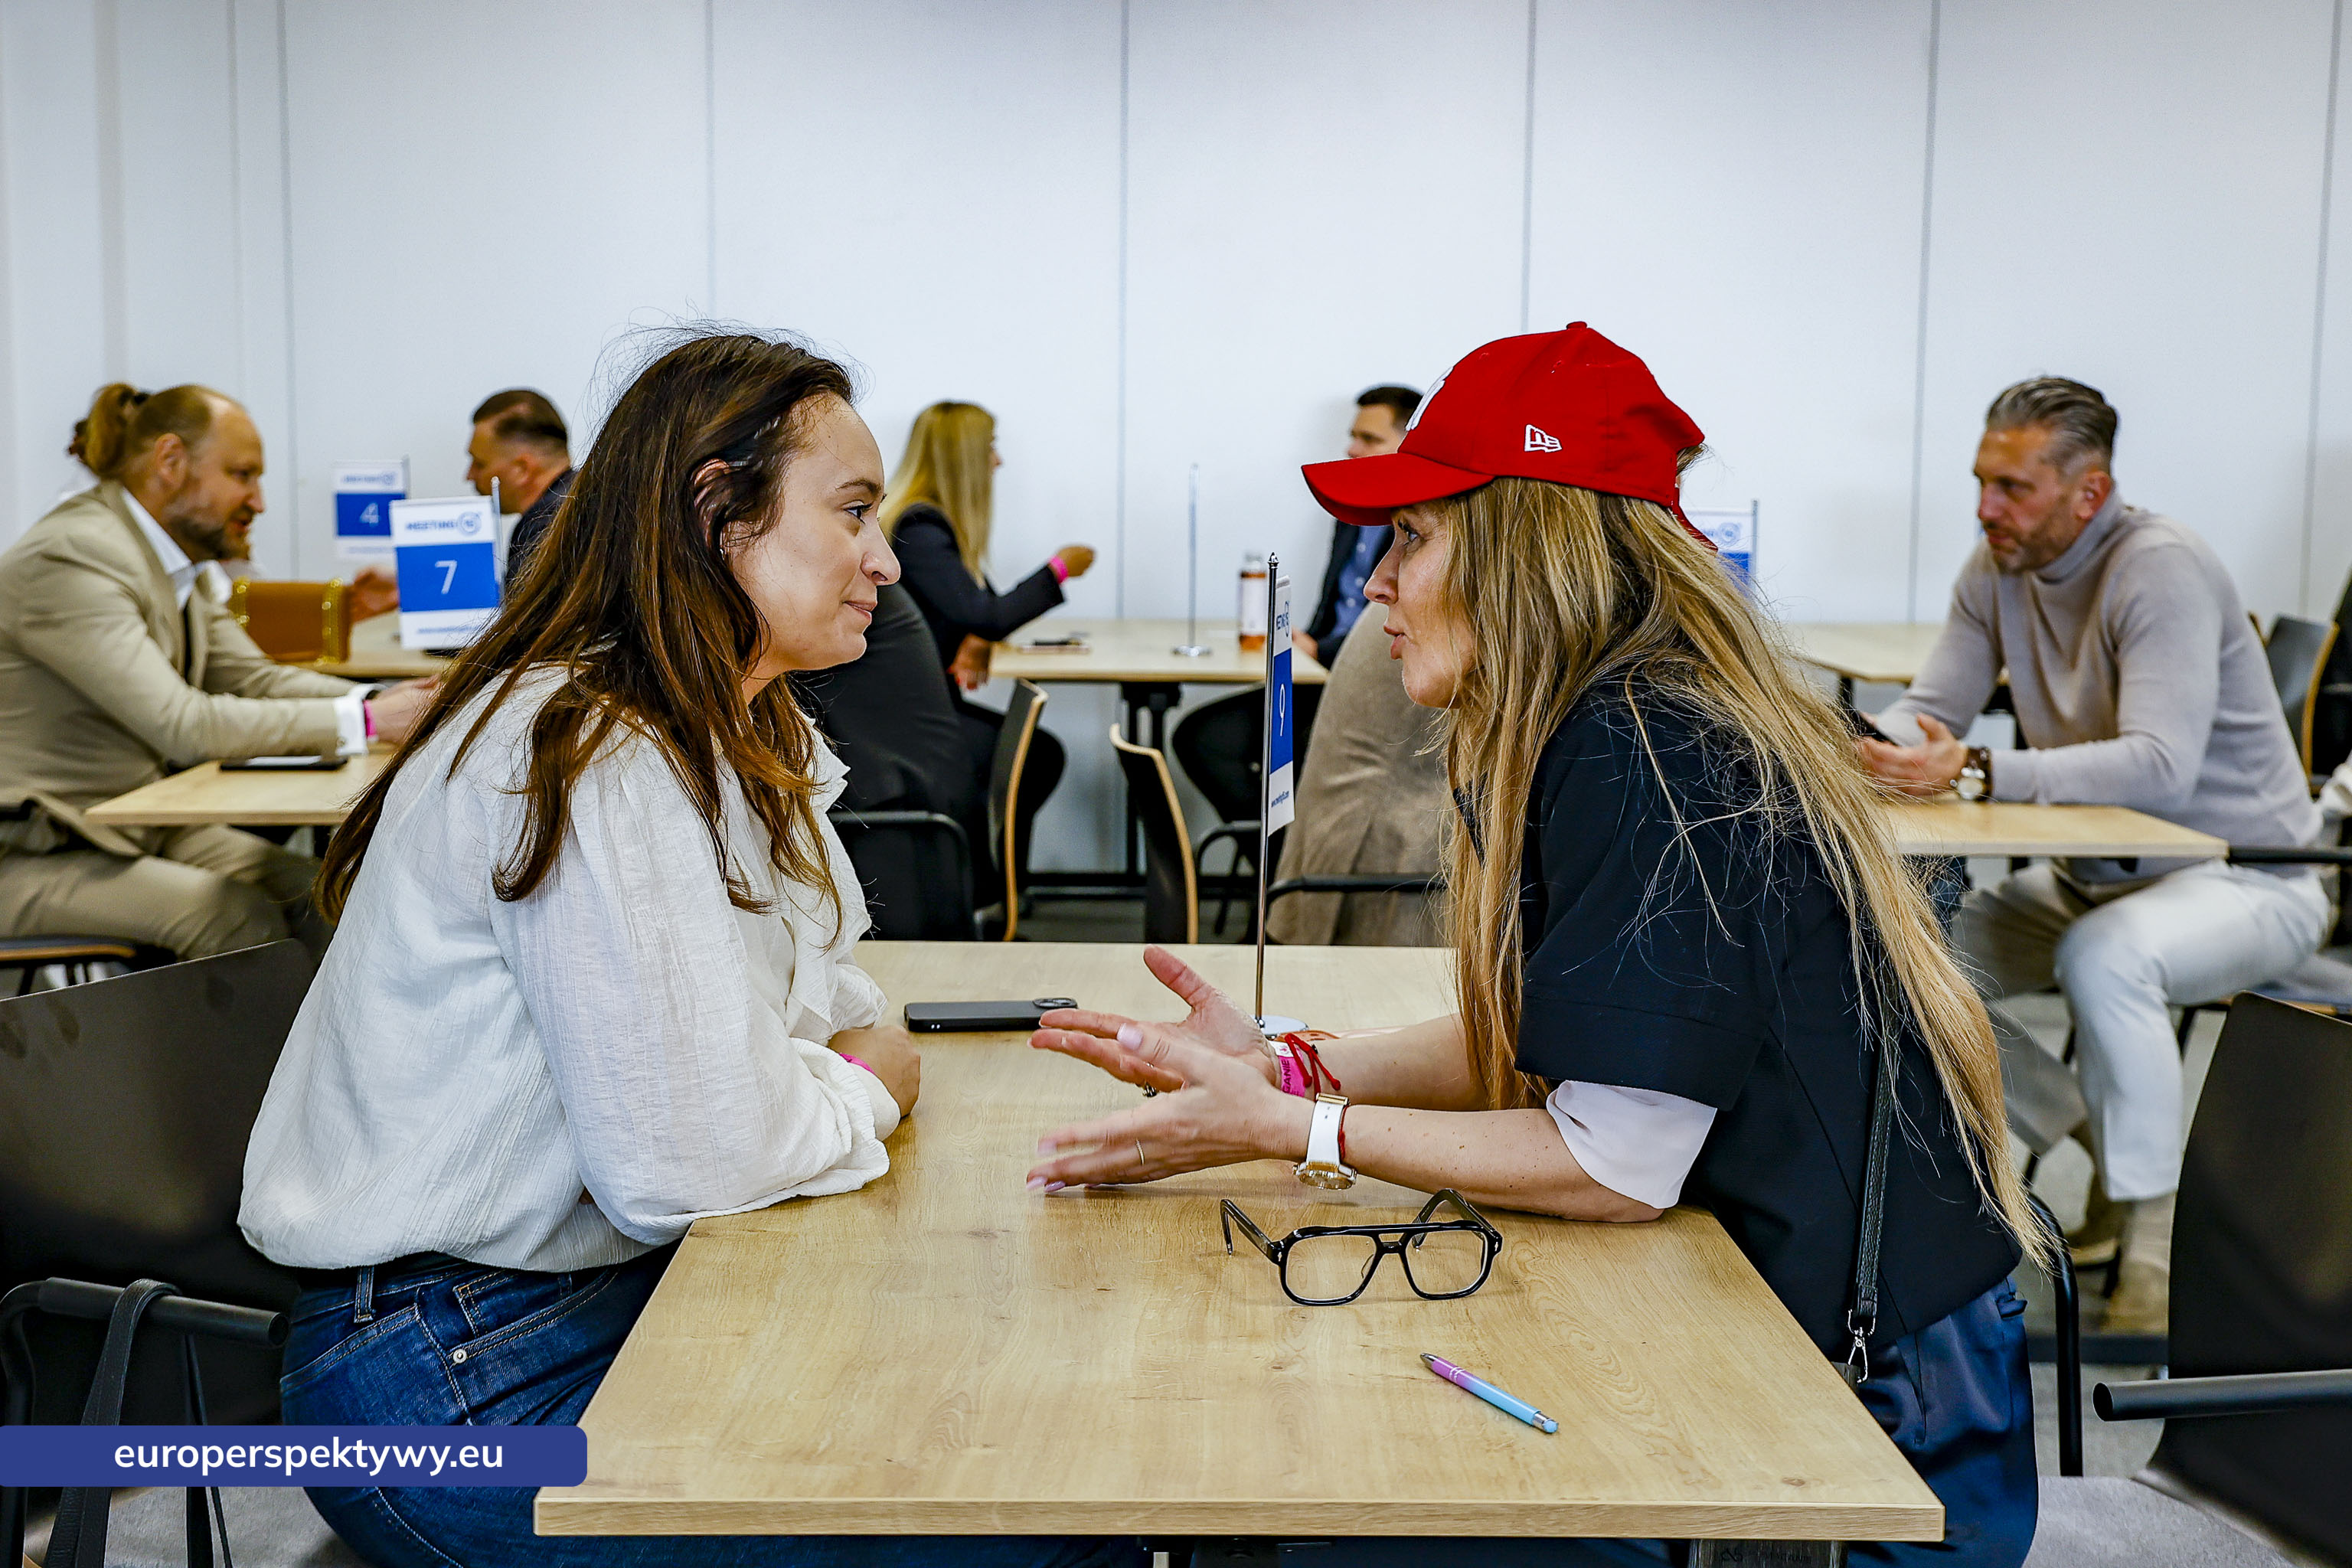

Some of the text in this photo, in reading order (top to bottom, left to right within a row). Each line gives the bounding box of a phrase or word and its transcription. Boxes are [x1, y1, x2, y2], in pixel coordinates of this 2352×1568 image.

[359, 501, 380, 526] 4
[435, 560, 458, 595] 7
[1279, 684, 1285, 736] 9
[1282, 1059, 1291, 1093] GANIE
